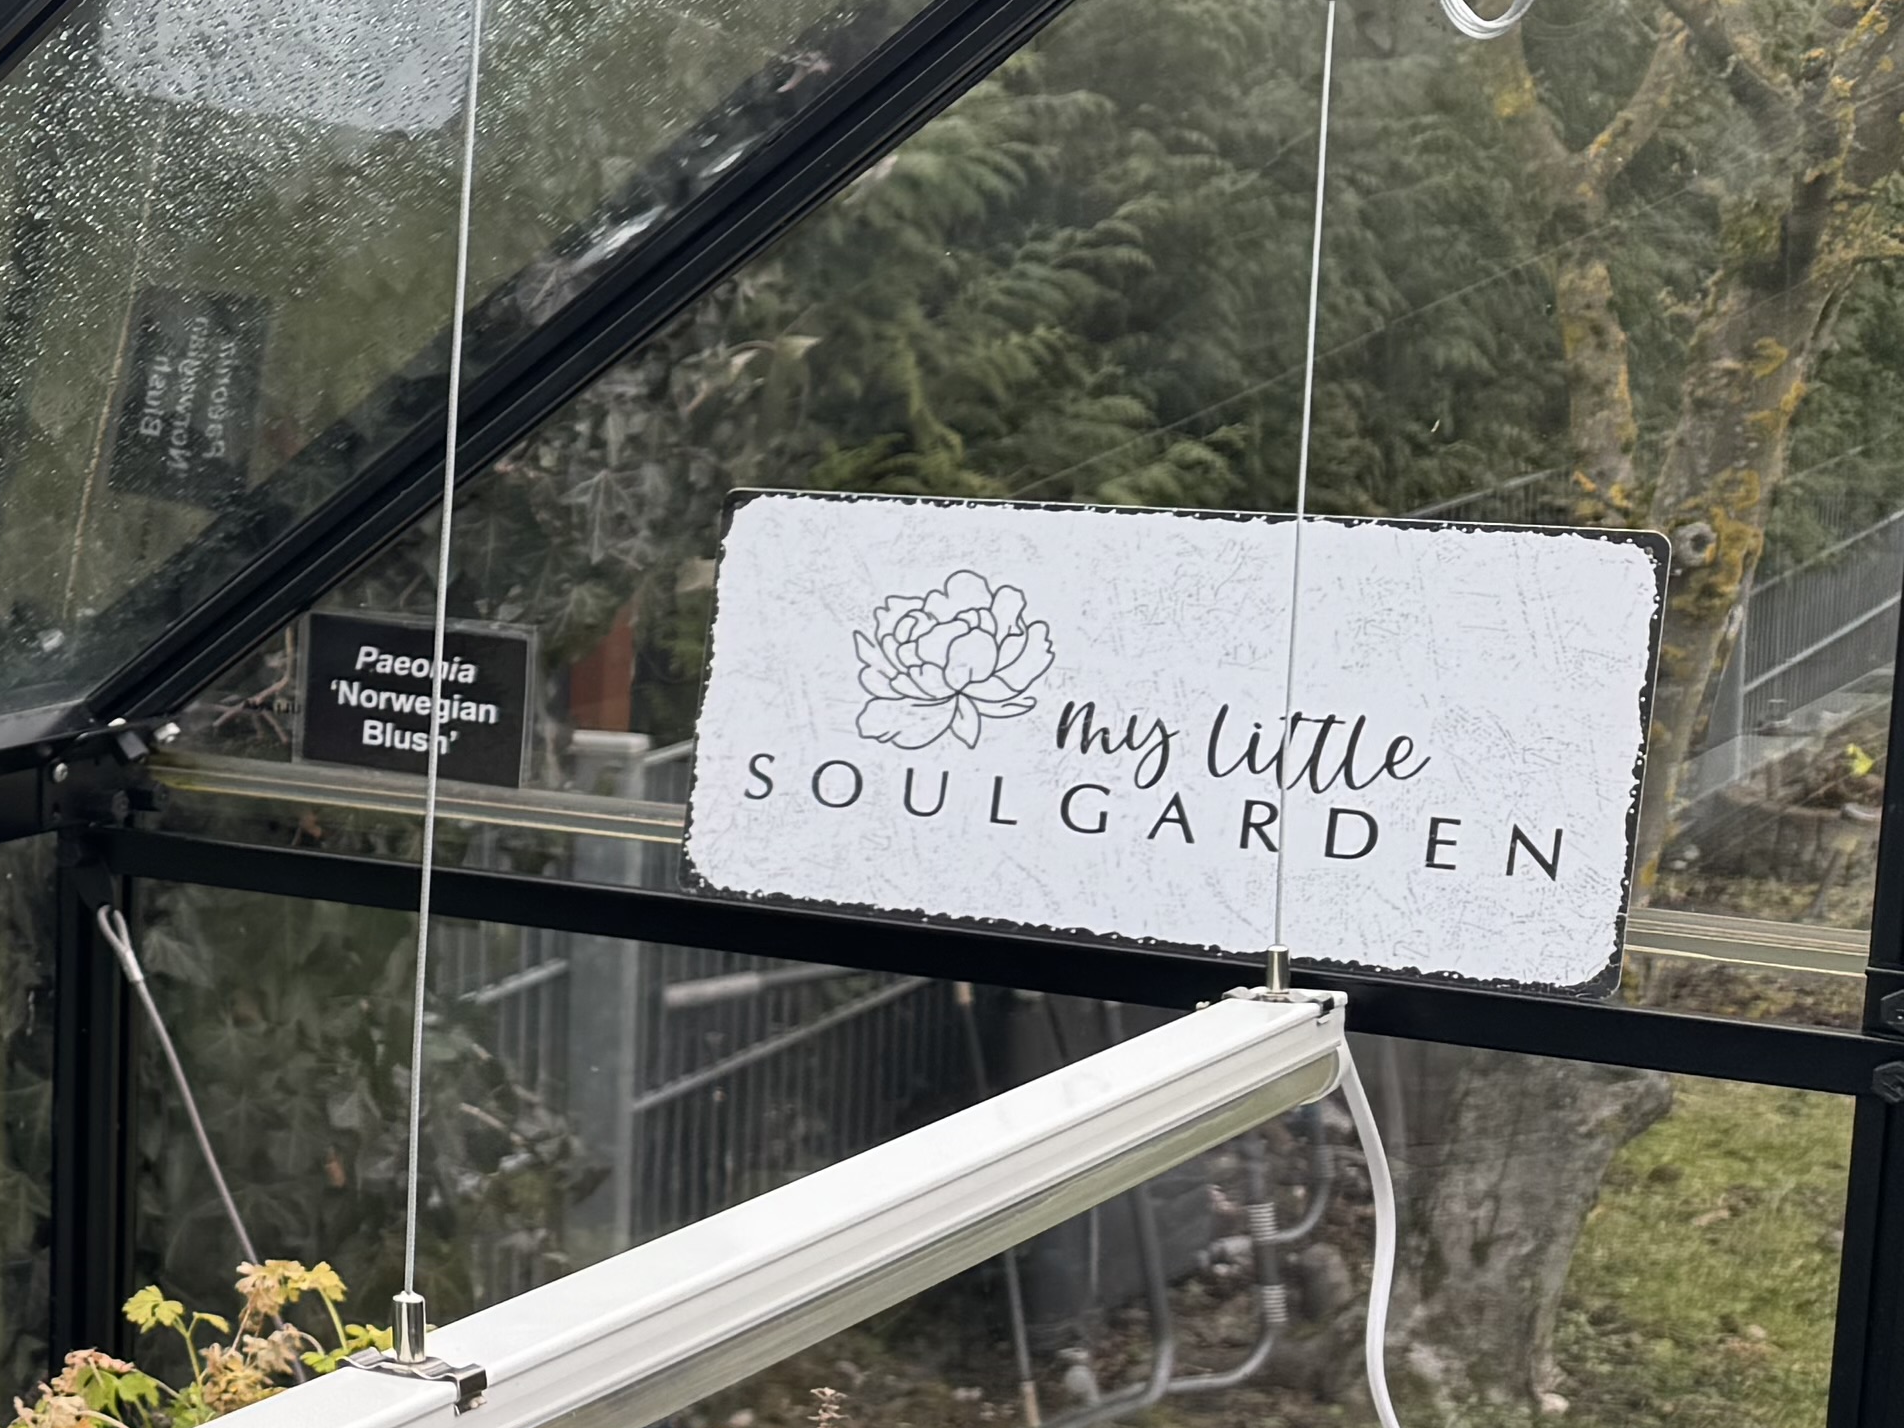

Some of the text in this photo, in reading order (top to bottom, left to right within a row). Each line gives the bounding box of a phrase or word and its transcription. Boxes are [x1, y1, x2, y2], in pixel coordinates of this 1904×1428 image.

[355, 644, 479, 685] Paeonia
[1055, 698, 1431, 795] my little
[744, 752, 1565, 881] SOULGARDEN
